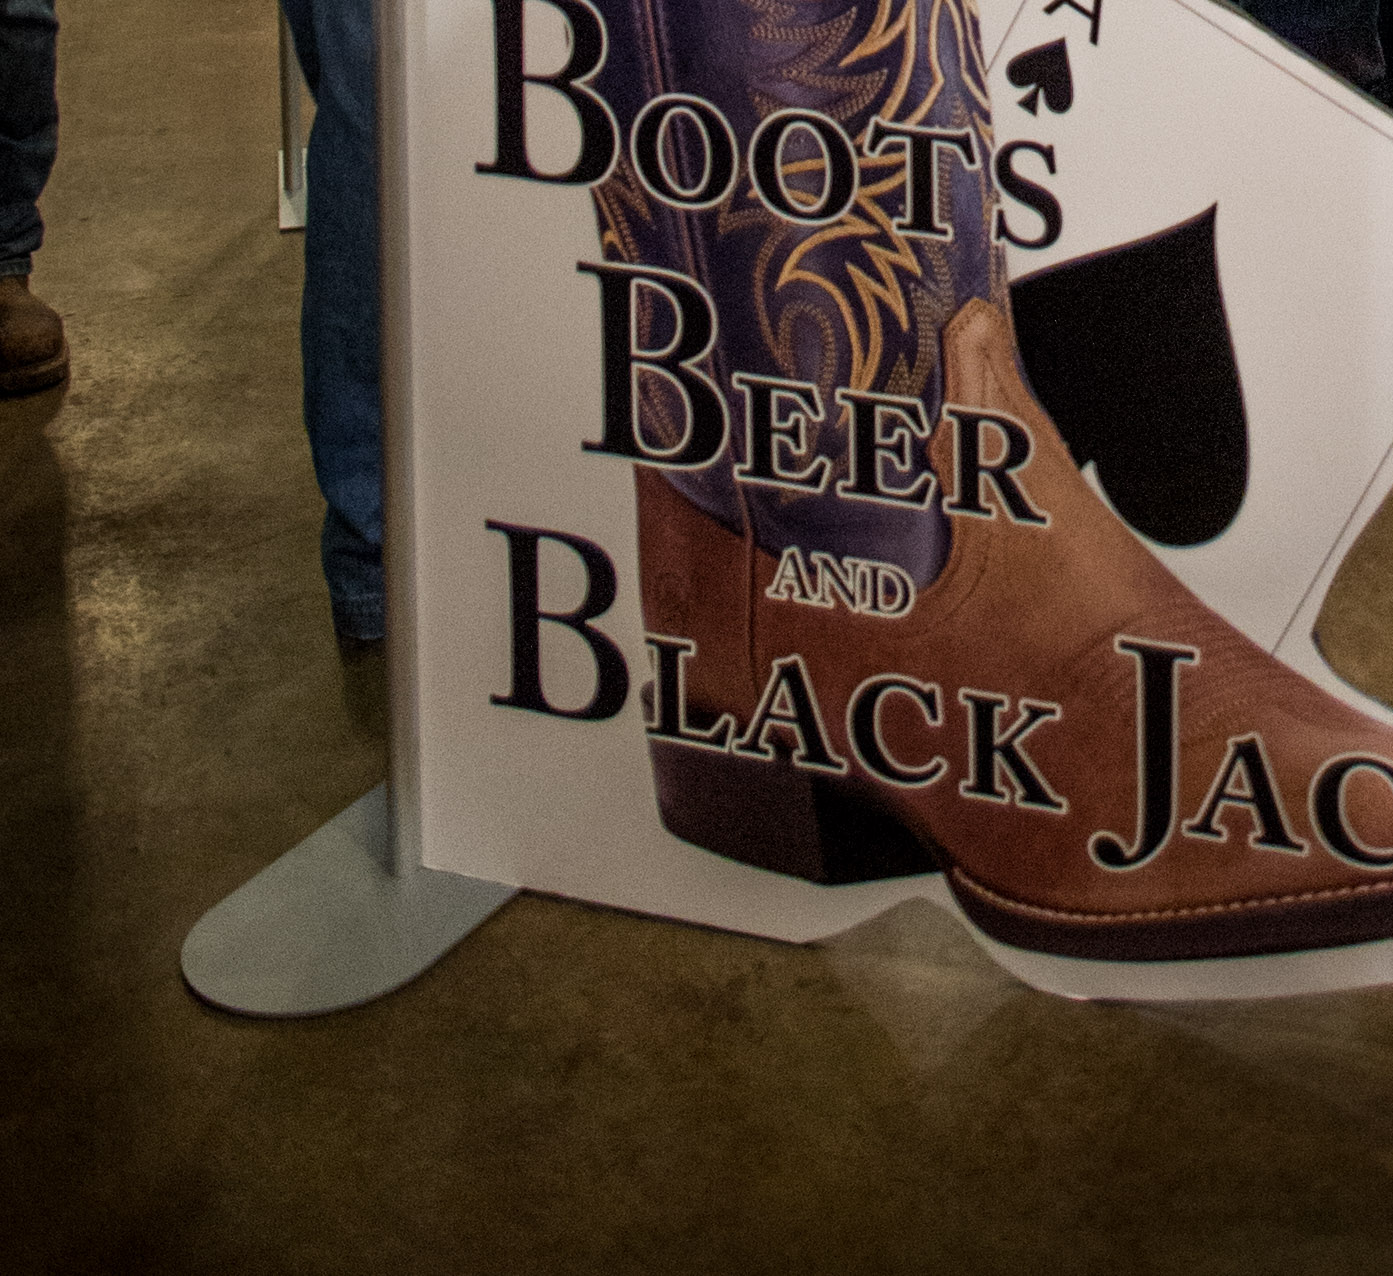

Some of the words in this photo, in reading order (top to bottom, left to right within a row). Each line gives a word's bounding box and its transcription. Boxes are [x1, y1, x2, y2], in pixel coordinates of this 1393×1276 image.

[576, 261, 1048, 526] BEER
[485, 520, 1067, 812] BLACK
[766, 550, 915, 616] AND
